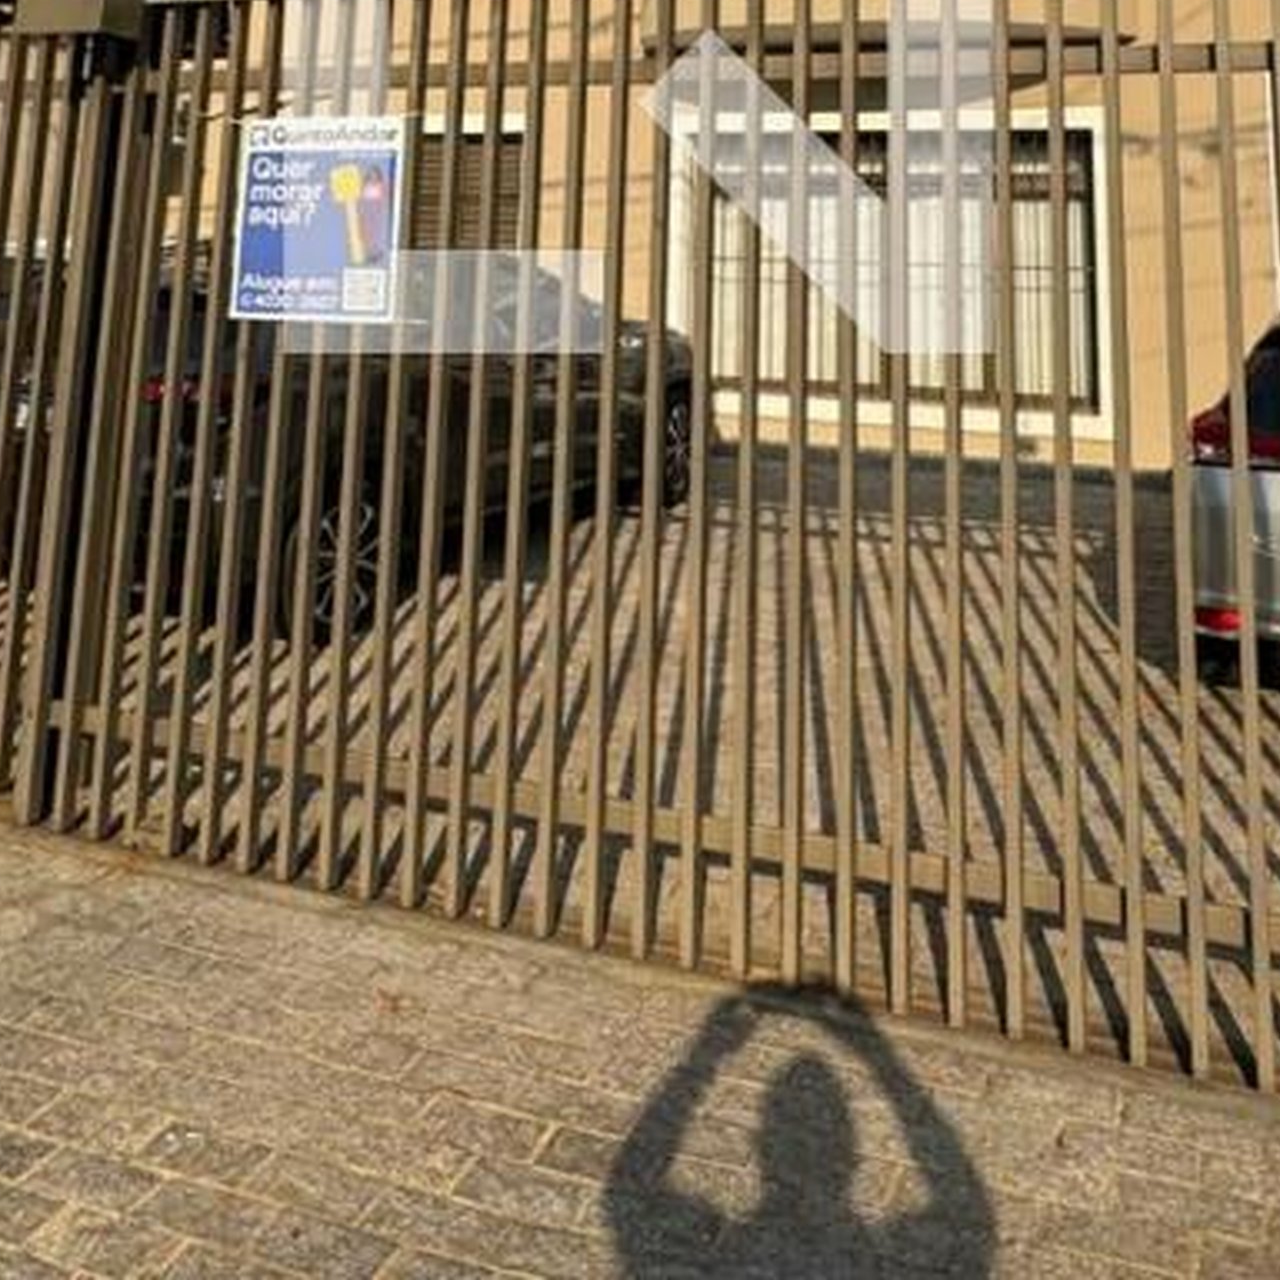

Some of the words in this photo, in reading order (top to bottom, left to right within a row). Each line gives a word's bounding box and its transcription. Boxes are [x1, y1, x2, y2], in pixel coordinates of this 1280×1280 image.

[252, 156, 317, 181] Quer
[249, 184, 322, 202] morar
[247, 202, 316, 230] aqui?
